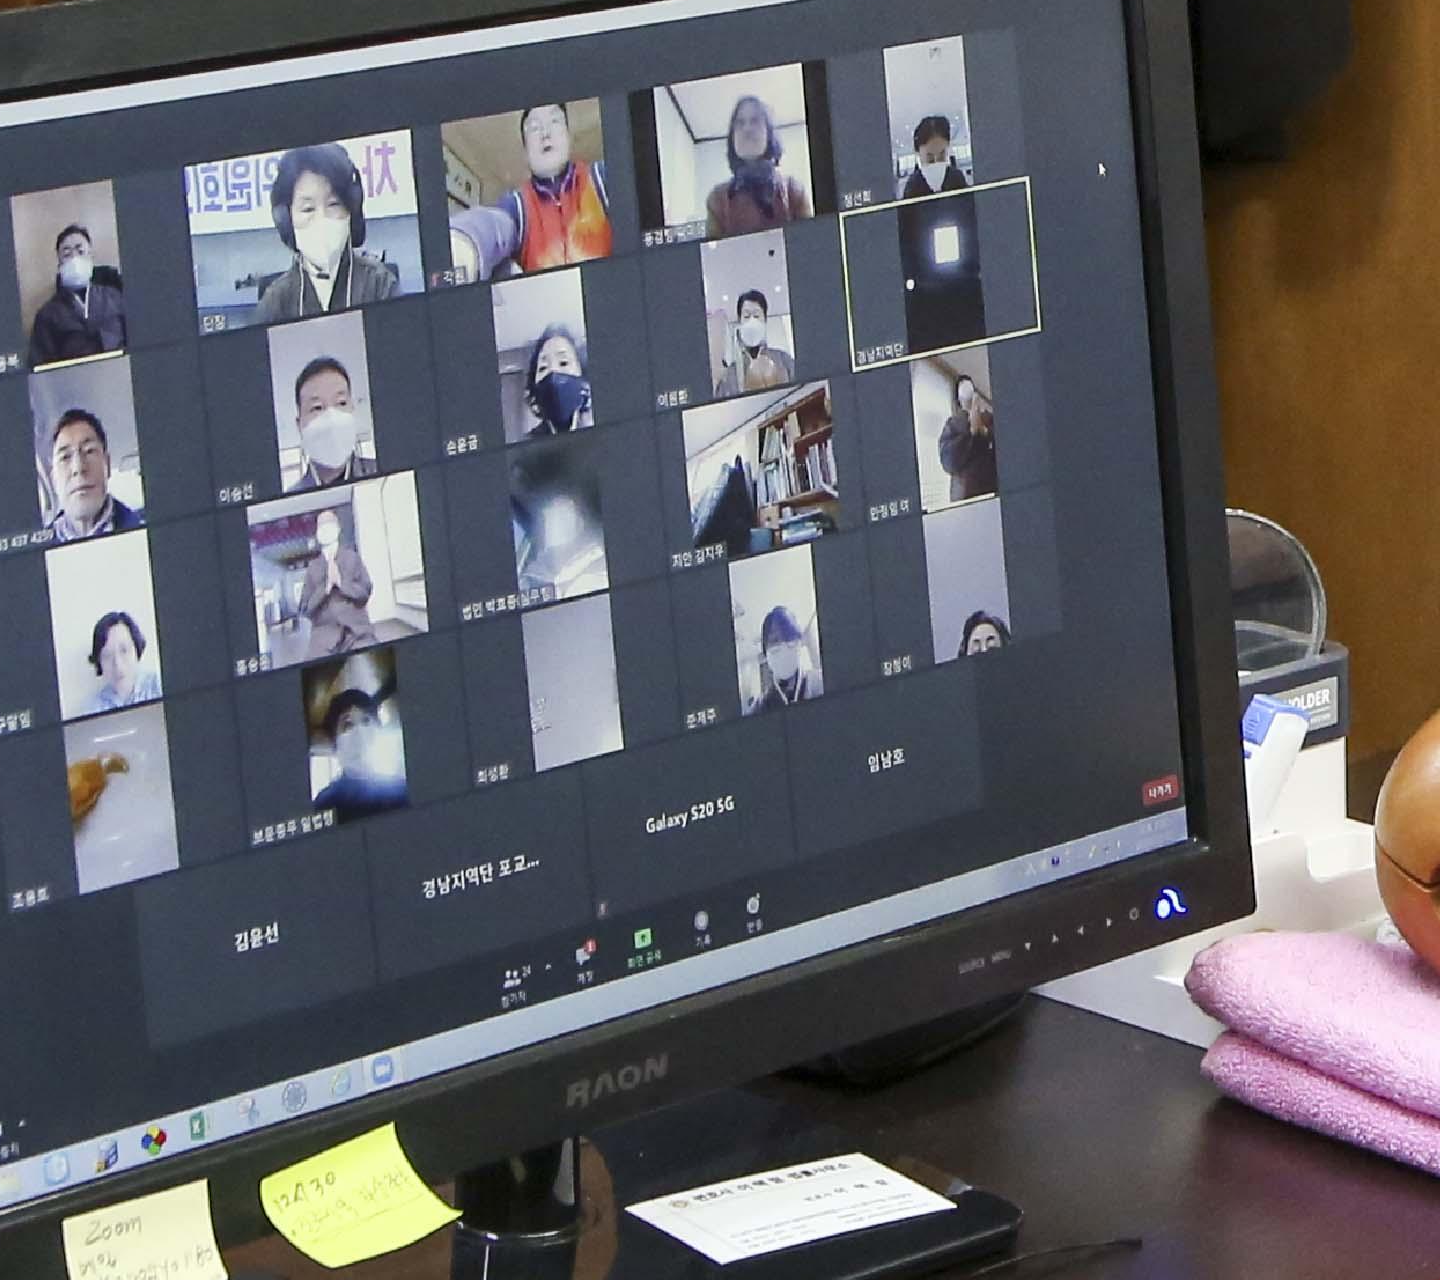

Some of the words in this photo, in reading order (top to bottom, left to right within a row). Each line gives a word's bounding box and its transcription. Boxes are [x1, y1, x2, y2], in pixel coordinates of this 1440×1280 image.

[867, 748, 906, 774] 임남호
[646, 806, 689, 834] Galaxy
[690, 801, 715, 822] S20
[716, 795, 736, 814] 5G
[422, 862, 494, 900] 경남지역단
[233, 922, 280, 953] 김윤선
[83, 1215, 143, 1247] Zoom
